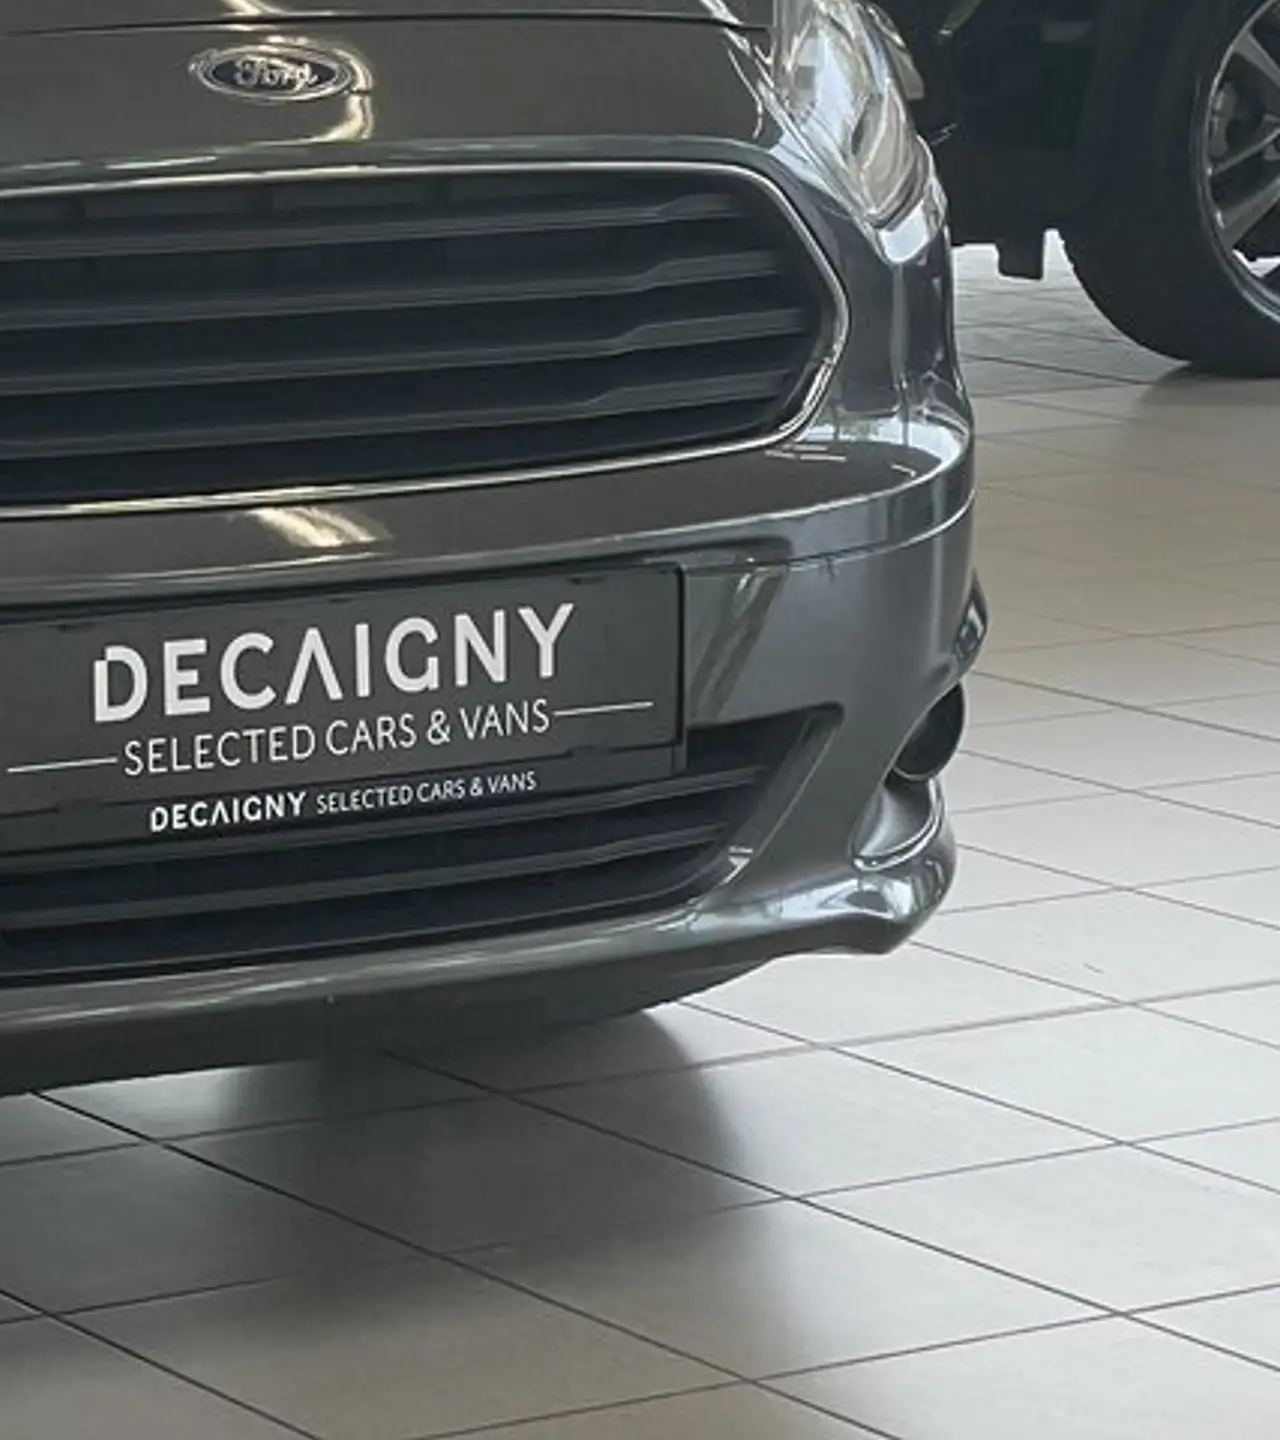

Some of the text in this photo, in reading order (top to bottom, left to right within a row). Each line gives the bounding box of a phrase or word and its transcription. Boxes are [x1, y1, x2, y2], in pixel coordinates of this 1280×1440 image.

[233, 54, 320, 92] Ford
[93, 602, 575, 723] DECAIGNY
[123, 698, 550, 776] SELECTED CARS & VANS
[149, 770, 538, 833] DECAIGNY SELECTED CARS & VANS
